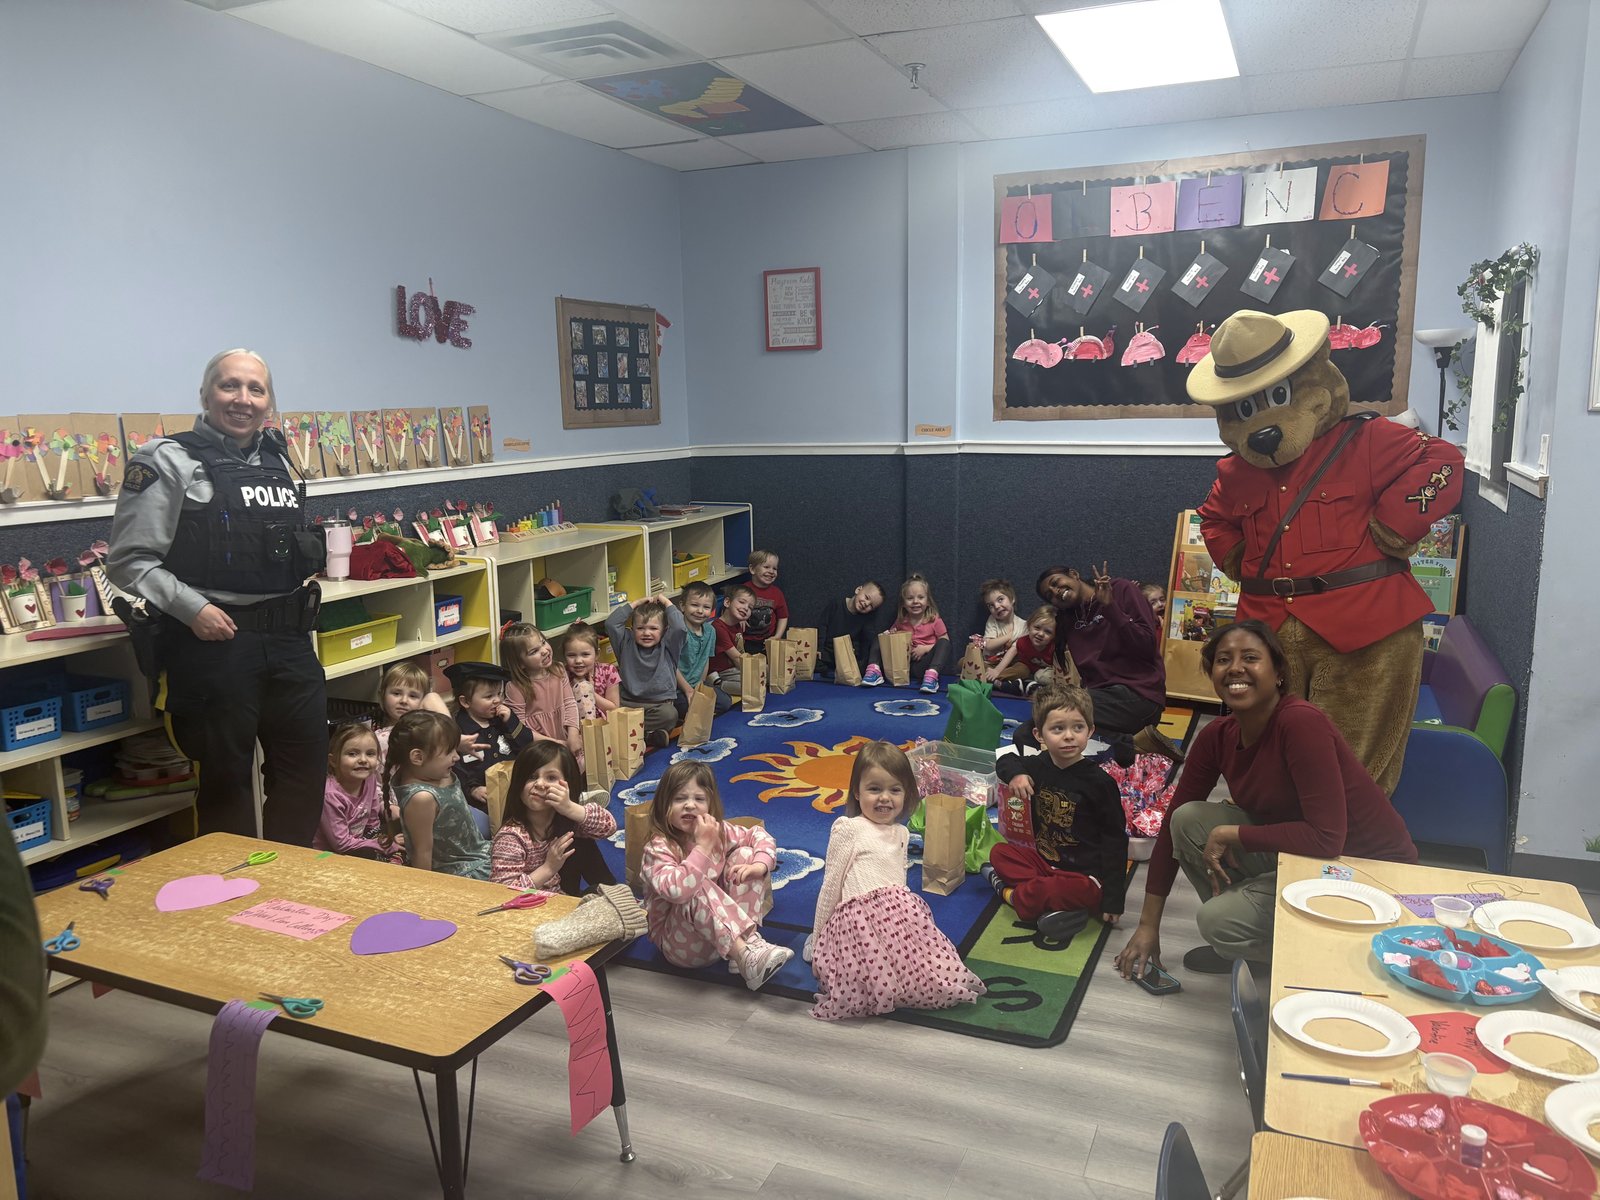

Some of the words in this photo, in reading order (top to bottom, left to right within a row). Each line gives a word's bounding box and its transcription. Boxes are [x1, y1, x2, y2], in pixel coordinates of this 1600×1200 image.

[1126, 192, 1152, 231] B
[1198, 184, 1225, 223] E
[1263, 180, 1293, 217] N
[1332, 171, 1363, 215] C
[397, 285, 475, 349] LOVE
[240, 486, 299, 508] POLICE
[982, 976, 1043, 1012] S
